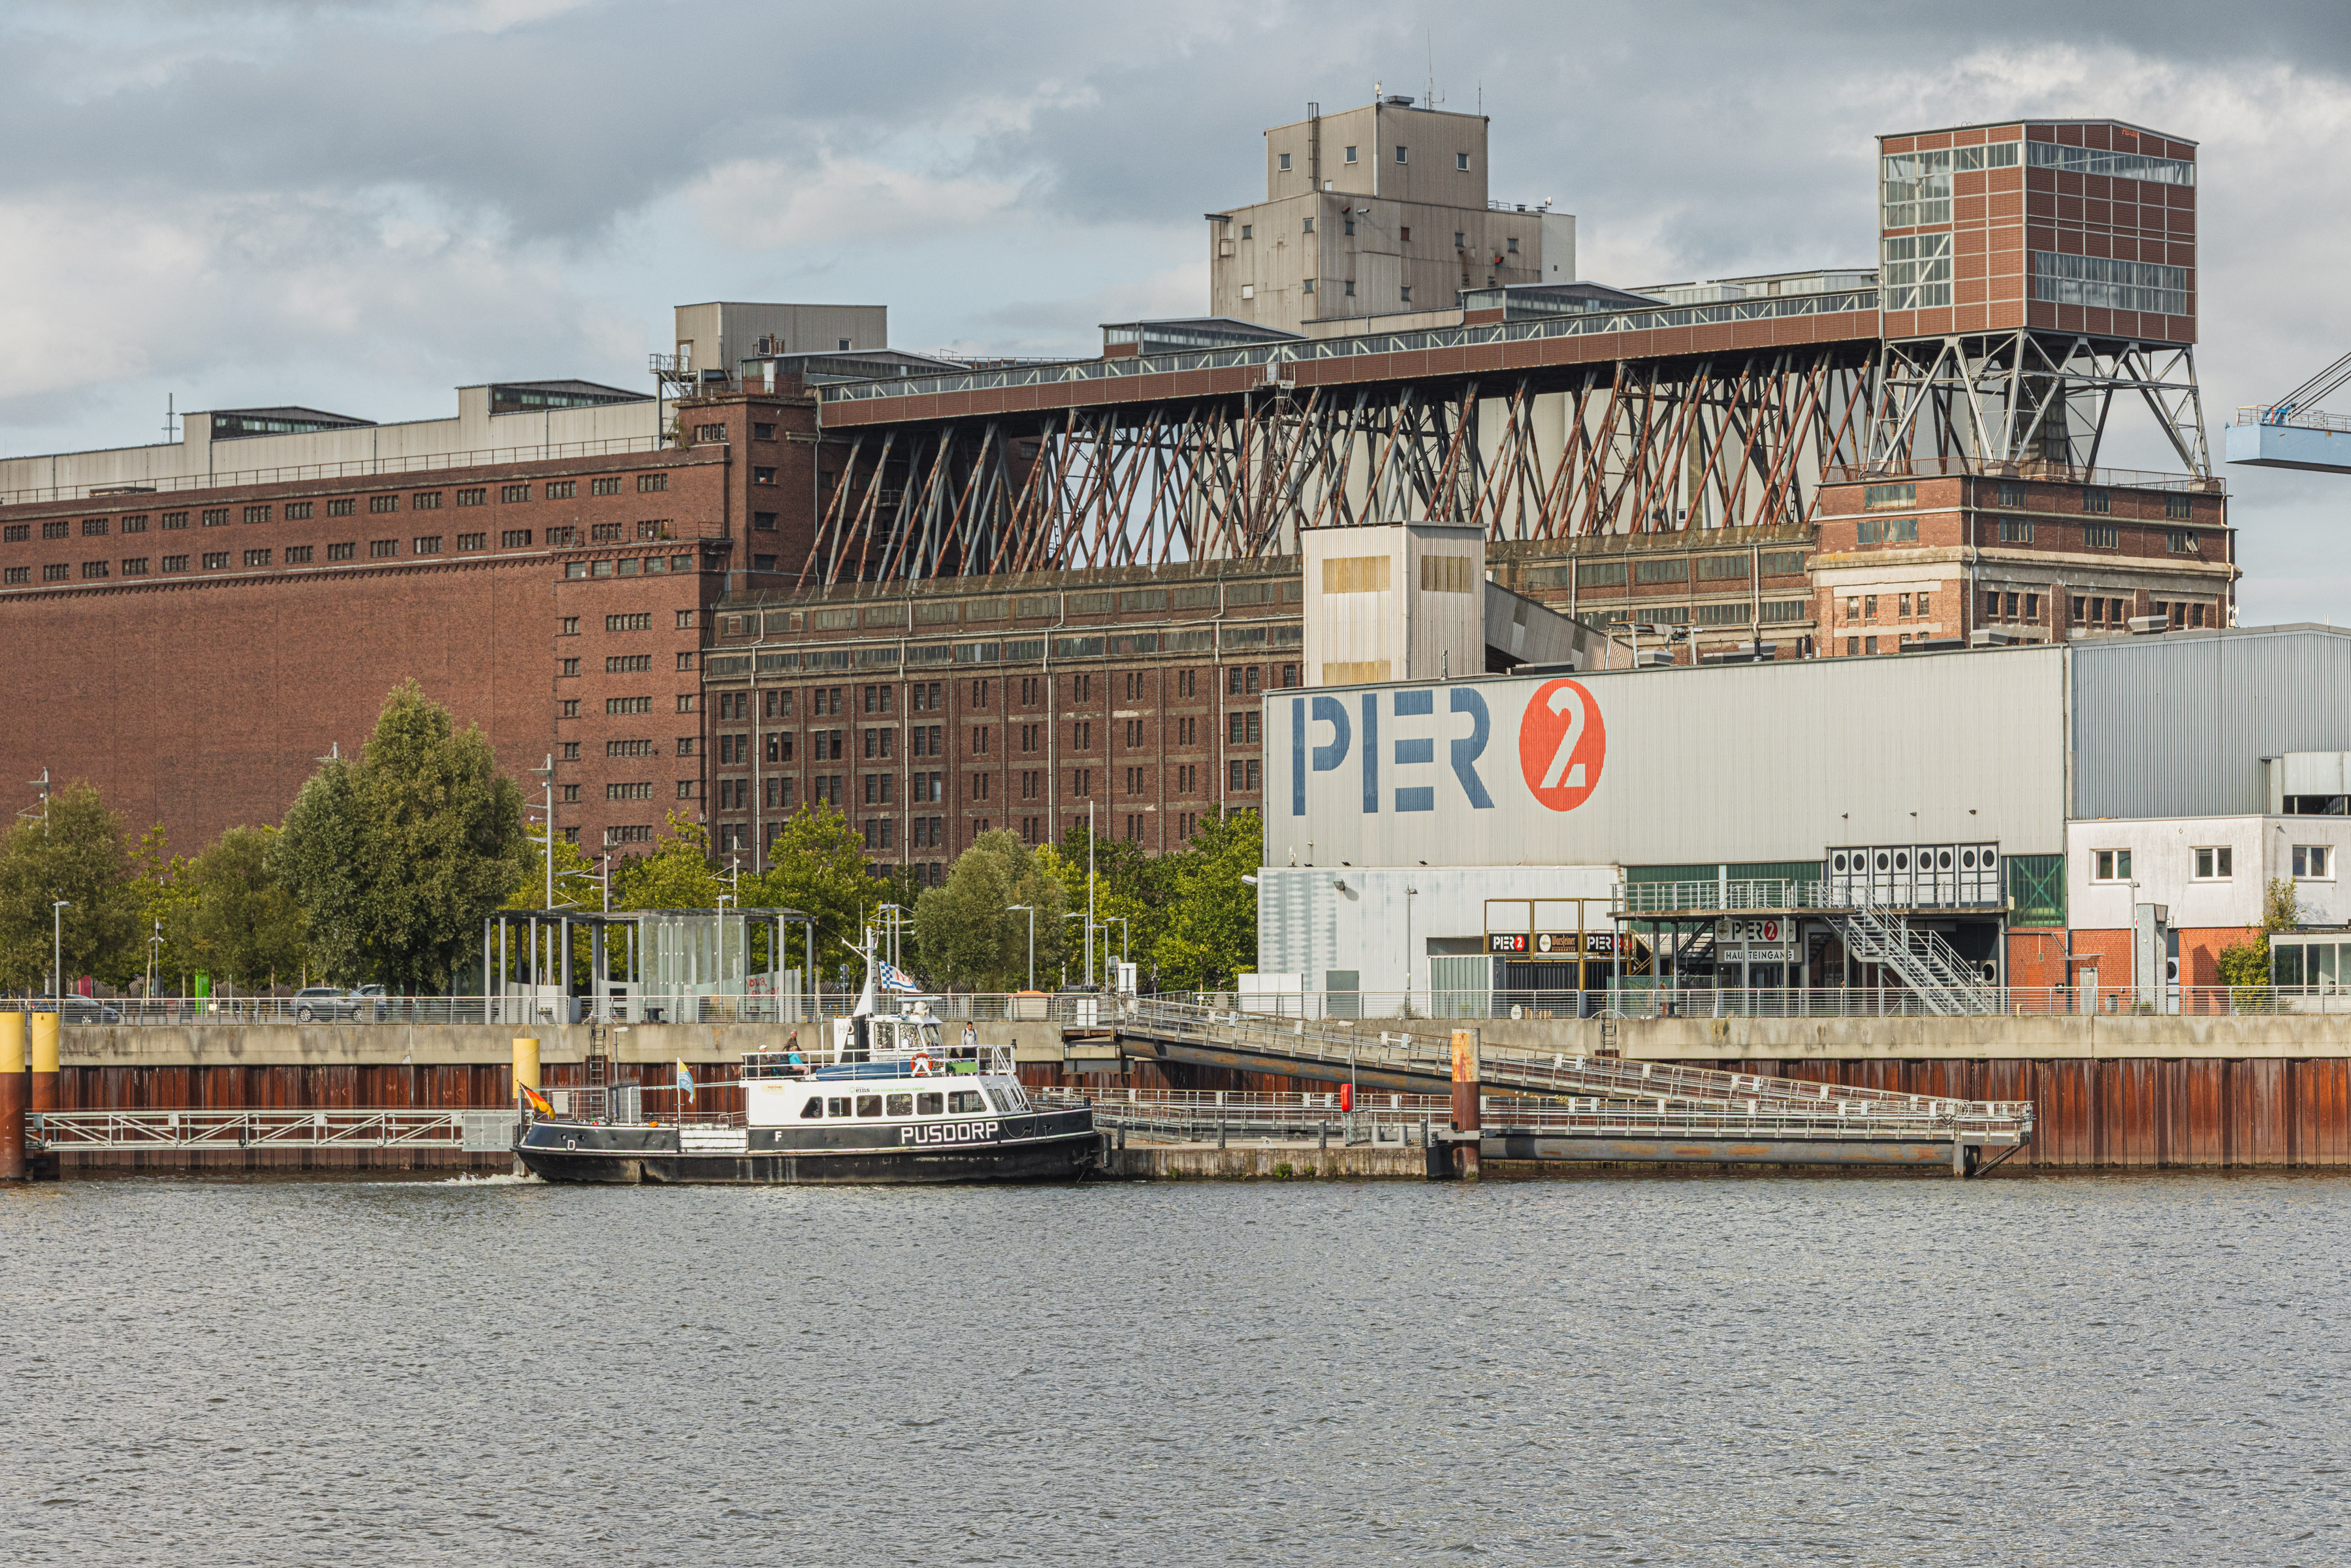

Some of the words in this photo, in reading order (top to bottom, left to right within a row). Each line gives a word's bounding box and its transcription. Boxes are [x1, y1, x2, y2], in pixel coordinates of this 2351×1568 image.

[1292, 686, 1495, 816] PIER
[1539, 686, 1586, 788] 2
[1731, 921, 1763, 940] PER
[1767, 922, 1775, 937] 2
[1493, 936, 1515, 950] PIER
[1587, 936, 1612, 950] PIER
[775, 1130, 782, 1142] F
[901, 1121, 999, 1144] PUSDORP
[567, 1140, 575, 1150] D
